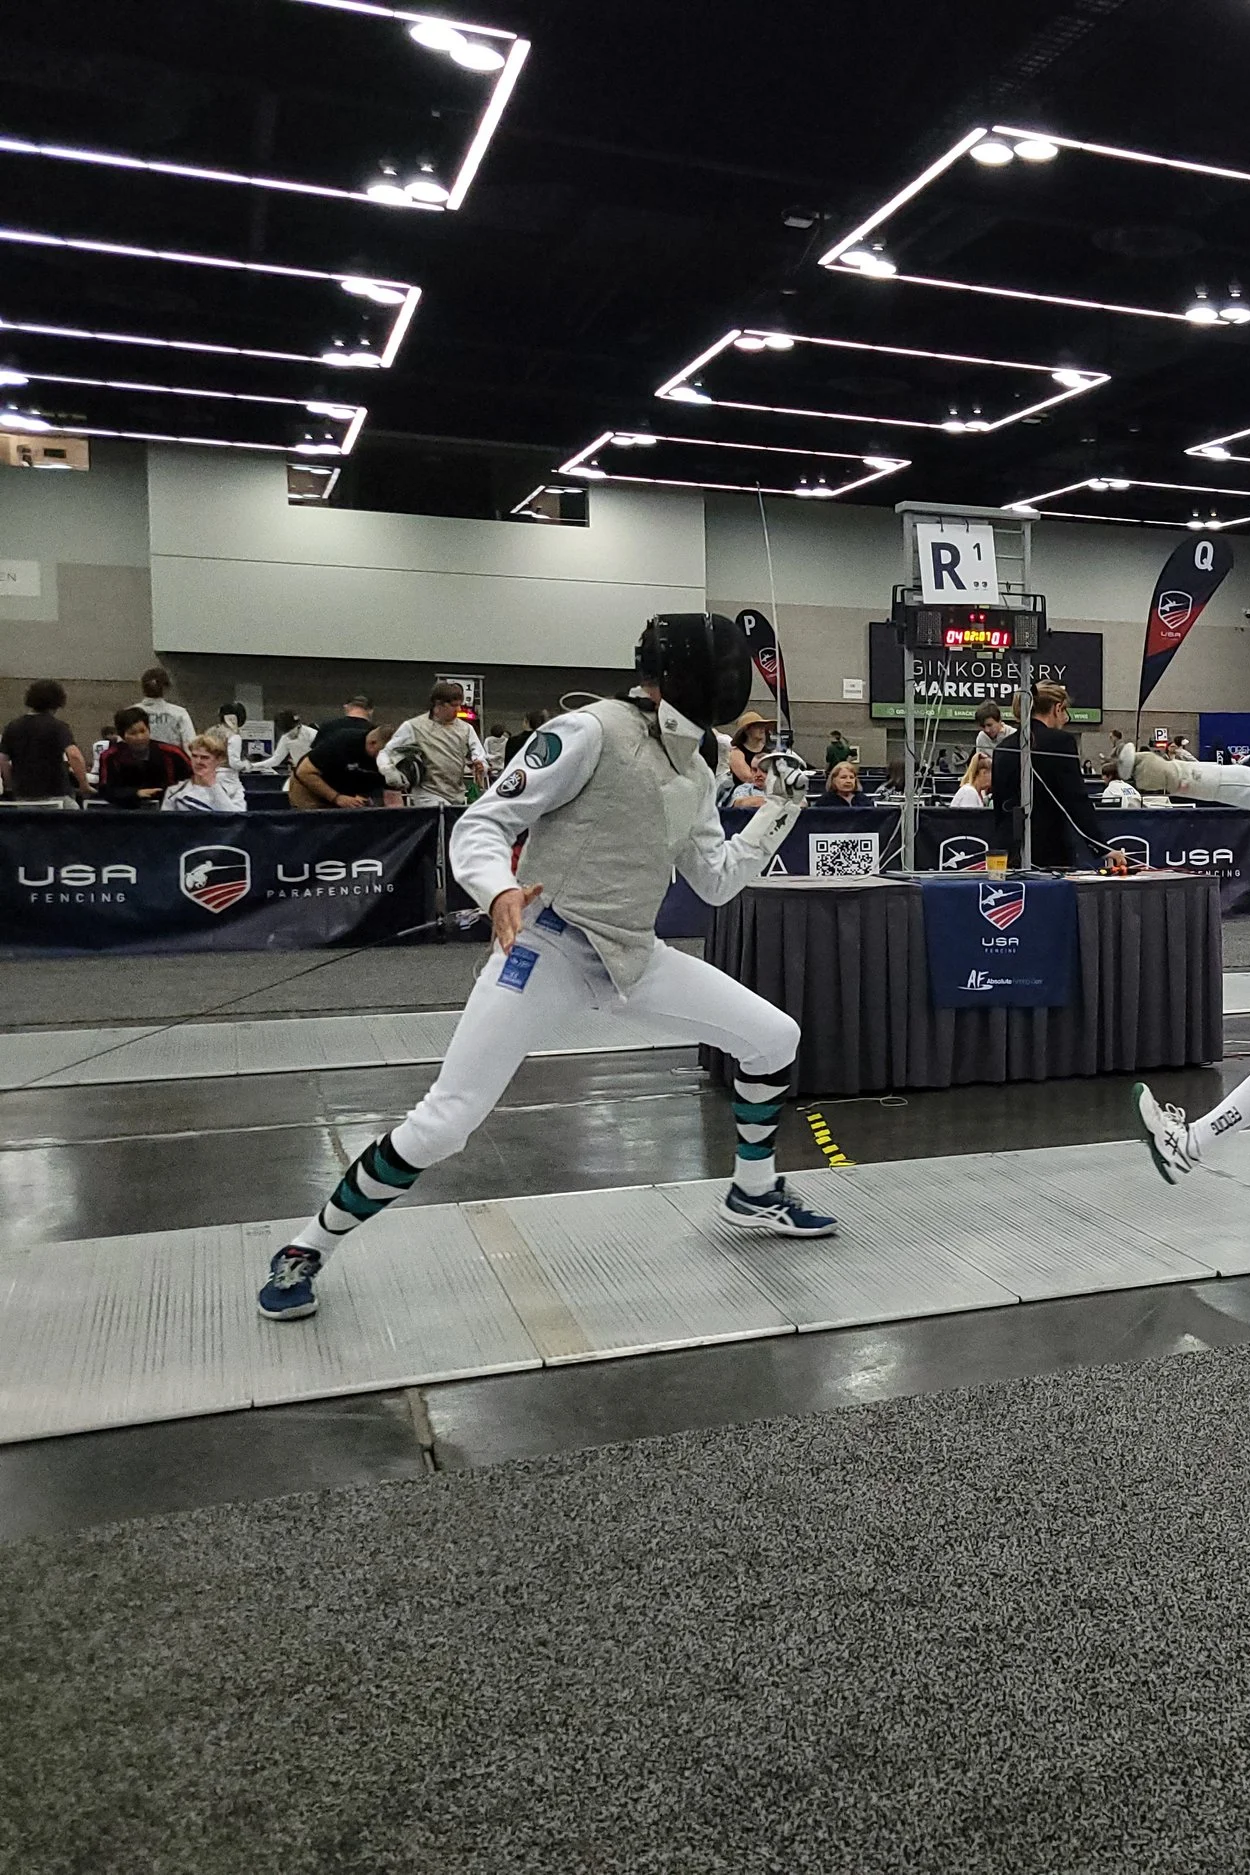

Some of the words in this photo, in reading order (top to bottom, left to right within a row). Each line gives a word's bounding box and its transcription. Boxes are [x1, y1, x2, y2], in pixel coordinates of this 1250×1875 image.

[930, 541, 967, 591] R
[972, 542, 982, 561] 1
[1194, 541, 1214, 571] Q
[743, 615, 756, 636] P
[913, 680, 1066, 700] MARKETP
[1156, 729, 1164, 740] P
[1166, 848, 1233, 866] USA
[18, 864, 137, 887] USA
[276, 859, 383, 883] USA
[31, 892, 126, 903] FENCING
[266, 883, 395, 899] PARAFENCING
[981, 937, 1020, 946] USA
